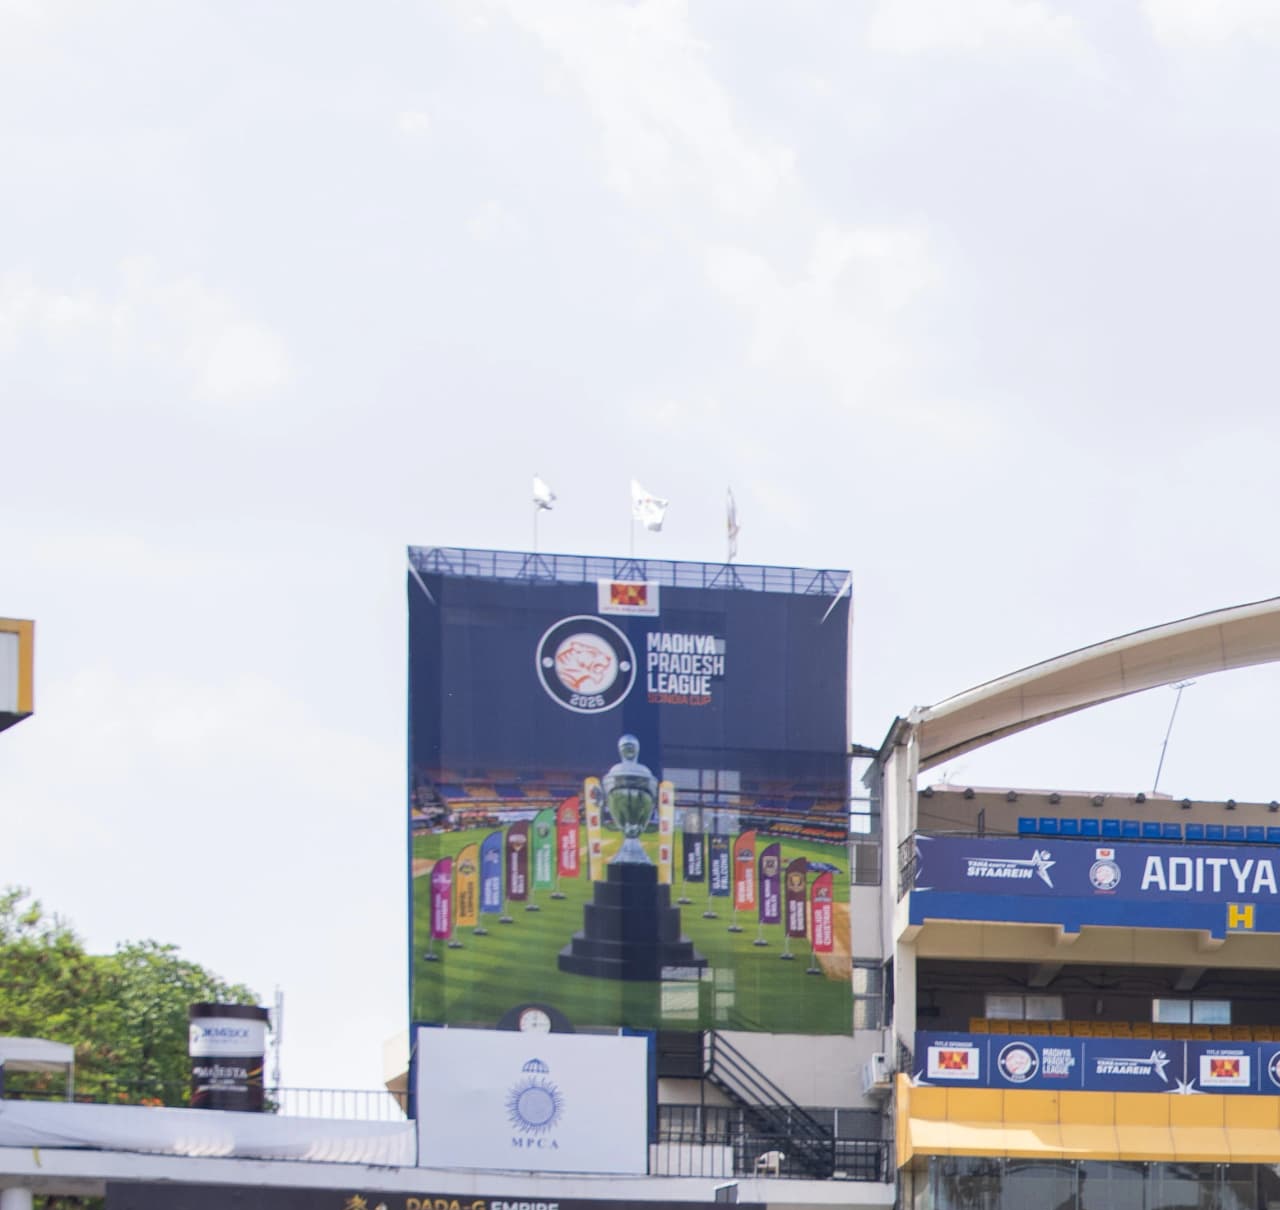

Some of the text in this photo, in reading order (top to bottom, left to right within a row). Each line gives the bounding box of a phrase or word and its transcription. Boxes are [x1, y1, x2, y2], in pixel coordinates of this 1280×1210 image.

[647, 633, 715, 654] MADHYA
[648, 653, 724, 675] PRADESH
[648, 674, 711, 695] LEAGUE
[967, 867, 1034, 880] SITAAREIN
[1141, 856, 1278, 894] ADITYA
